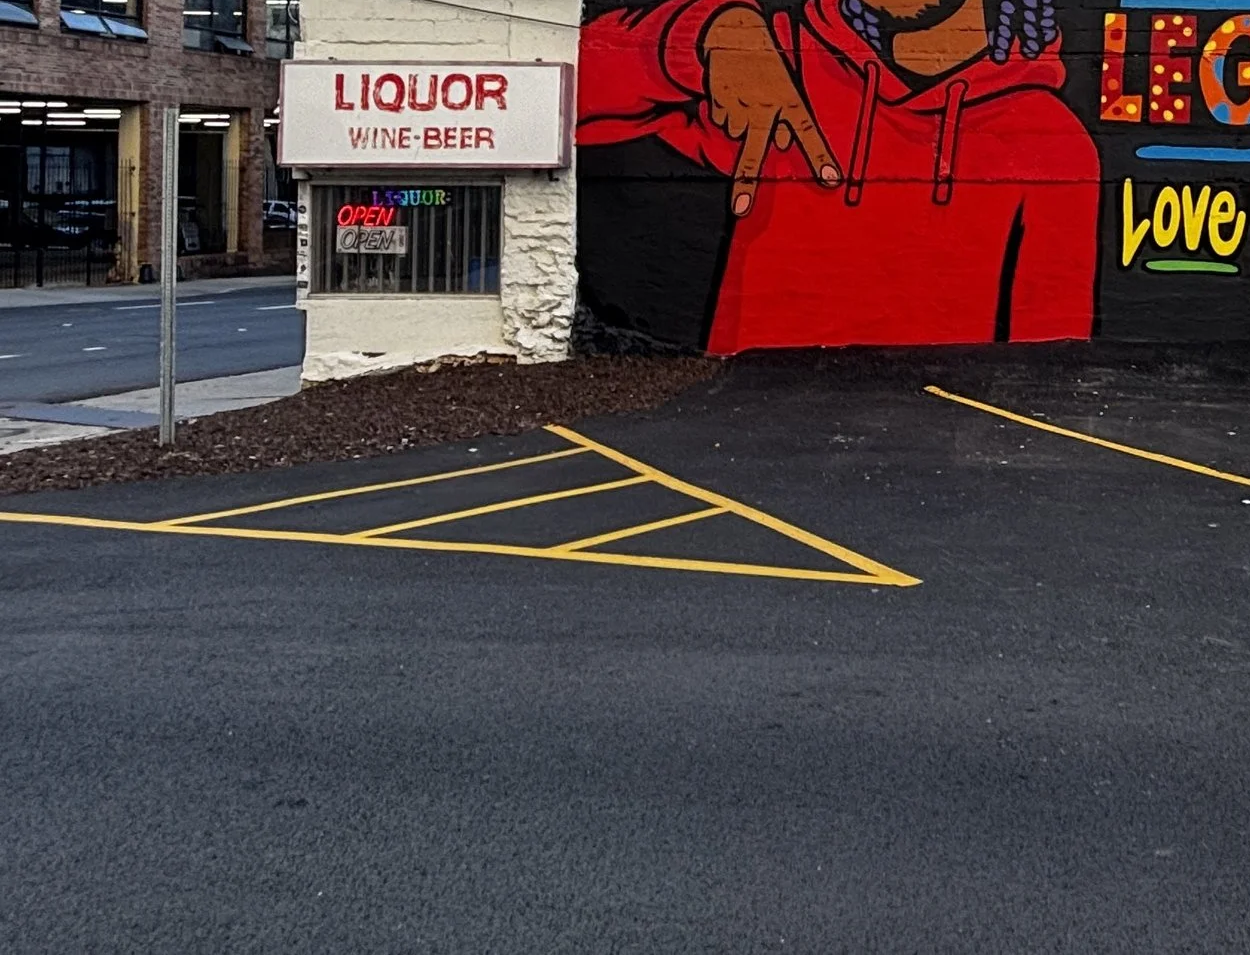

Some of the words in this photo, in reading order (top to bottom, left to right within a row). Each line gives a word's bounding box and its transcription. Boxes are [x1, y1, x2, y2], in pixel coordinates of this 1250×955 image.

[334, 72, 509, 113] LIQUOR
[337, 204, 395, 227] OPEN
[340, 228, 396, 250] OPEN
